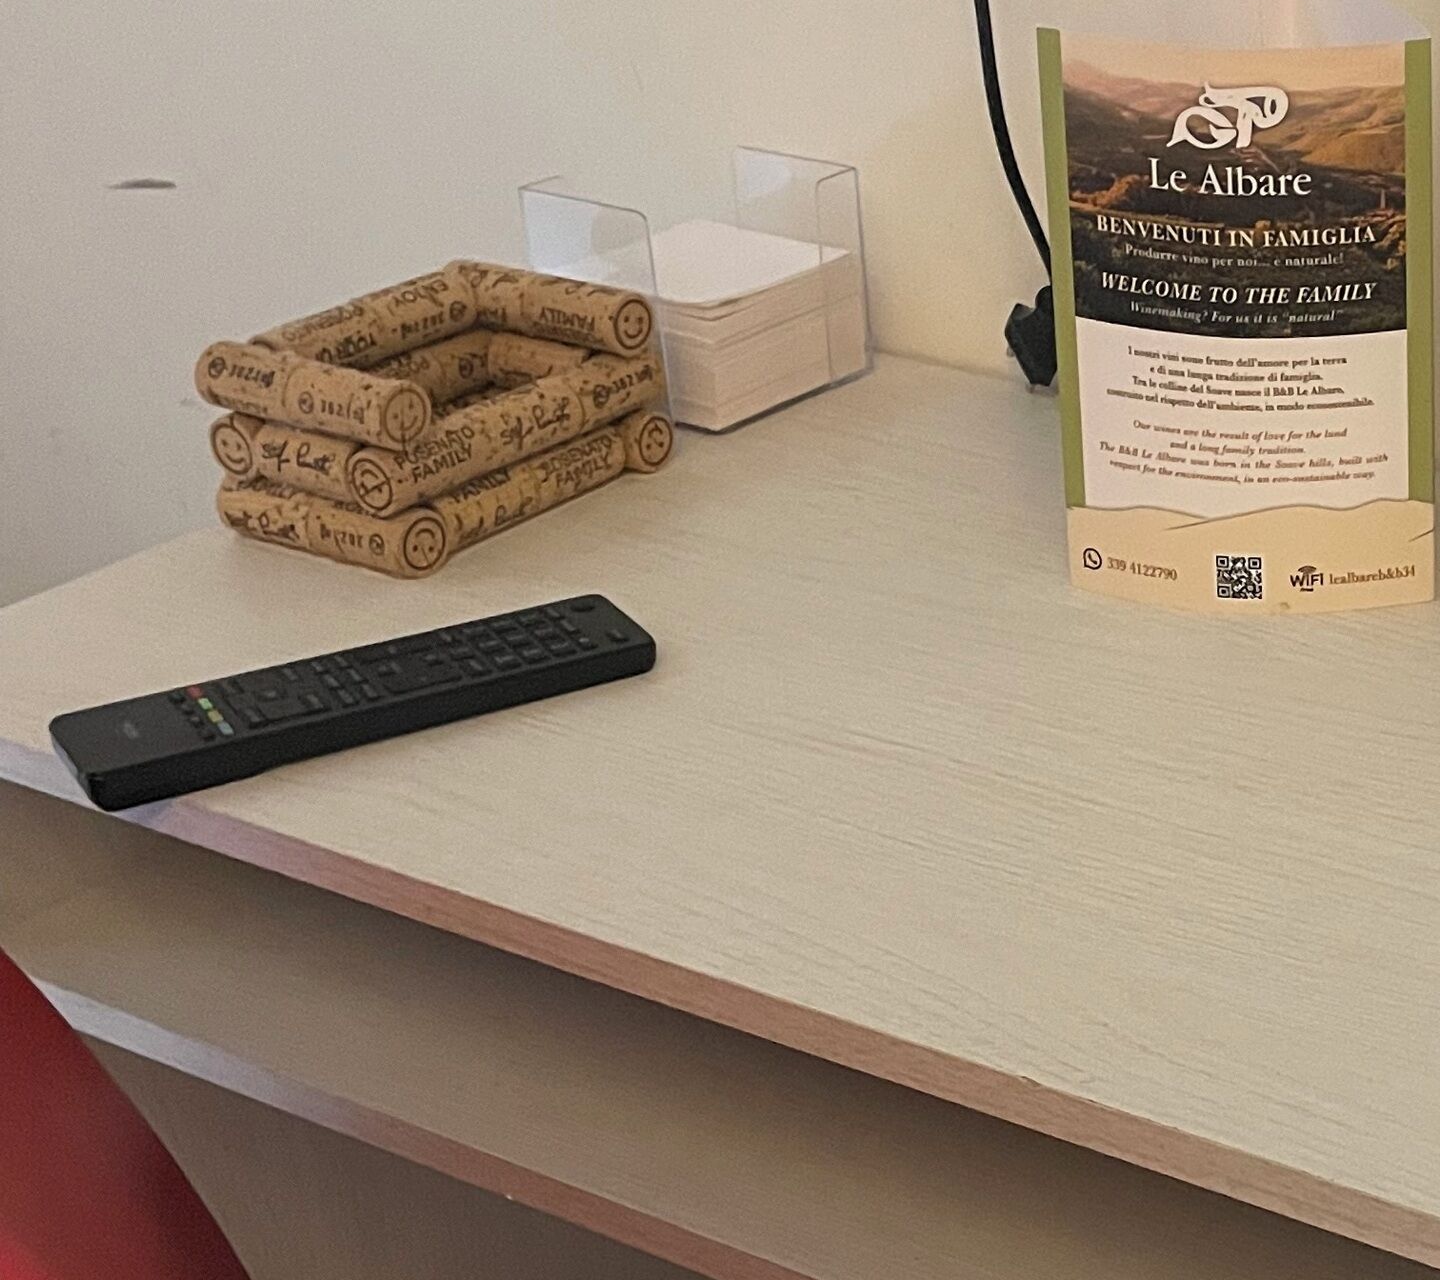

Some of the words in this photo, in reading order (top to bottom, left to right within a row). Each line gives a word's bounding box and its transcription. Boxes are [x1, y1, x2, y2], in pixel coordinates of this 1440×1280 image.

[1148, 157, 1187, 192] Le
[1199, 164, 1312, 196] Albare
[1096, 214, 1221, 246] BENVENUTI
[1227, 230, 1254, 247] IN
[1263, 225, 1376, 248] FAMIGLIA
[1125, 244, 1179, 261] Produrre
[1182, 251, 1208, 264] vino
[1212, 258, 1233, 269] per
[1285, 252, 1344, 266] naturale!
[1102, 272, 1202, 301] WELCOME
[1209, 286, 1237, 304] TO
[1245, 287, 1291, 304] THE
[1296, 282, 1377, 304] FAMILY
[1130, 301, 1208, 323] Winemaking?
[1211, 311, 1233, 323] For
[1235, 315, 1249, 323] us
[1254, 313, 1263, 323] it
[1266, 313, 1278, 323] is
[1157, 365, 1166, 375] di
[1187, 369, 1213, 382] lunga
[1216, 372, 1265, 382] tradizione
[1268, 372, 1278, 382] di
[1292, 359, 1309, 369] per
[1311, 357, 1320, 366] la
[1322, 357, 1347, 365] terra
[1132, 375, 1147, 387] Tra
[1149, 378, 1157, 388] le
[1190, 384, 1204, 394] del
[1264, 387, 1270, 396] il
[1273, 387, 1294, 396] B&B
[1297, 387, 1308, 396] Le
[1133, 420, 1151, 430] Our
[1202, 429, 1216, 438] the
[1252, 431, 1263, 443] of
[1264, 431, 1285, 440] love
[1287, 431, 1303, 442] for
[1306, 430, 1322, 439] the
[1324, 427, 1347, 438] land
[1100, 441, 1115, 452] The
[1142, 449, 1153, 459] Le
[1241, 459, 1250, 469] in
[1255, 459, 1270, 469] the
[1309, 458, 1334, 469] hills,
[1339, 456, 1362, 466] built
[1366, 453, 1388, 464] with
[1199, 443, 1219, 455] long
[1221, 444, 1255, 456] family
[411, 442, 472, 483] FAMILY
[555, 452, 611, 490] FAMILY
[1142, 464, 1156, 474] for
[1158, 467, 1173, 476] the
[1244, 475, 1254, 483] in
[1107, 556, 1126, 571] 339
[1130, 561, 1178, 581] 4122790
